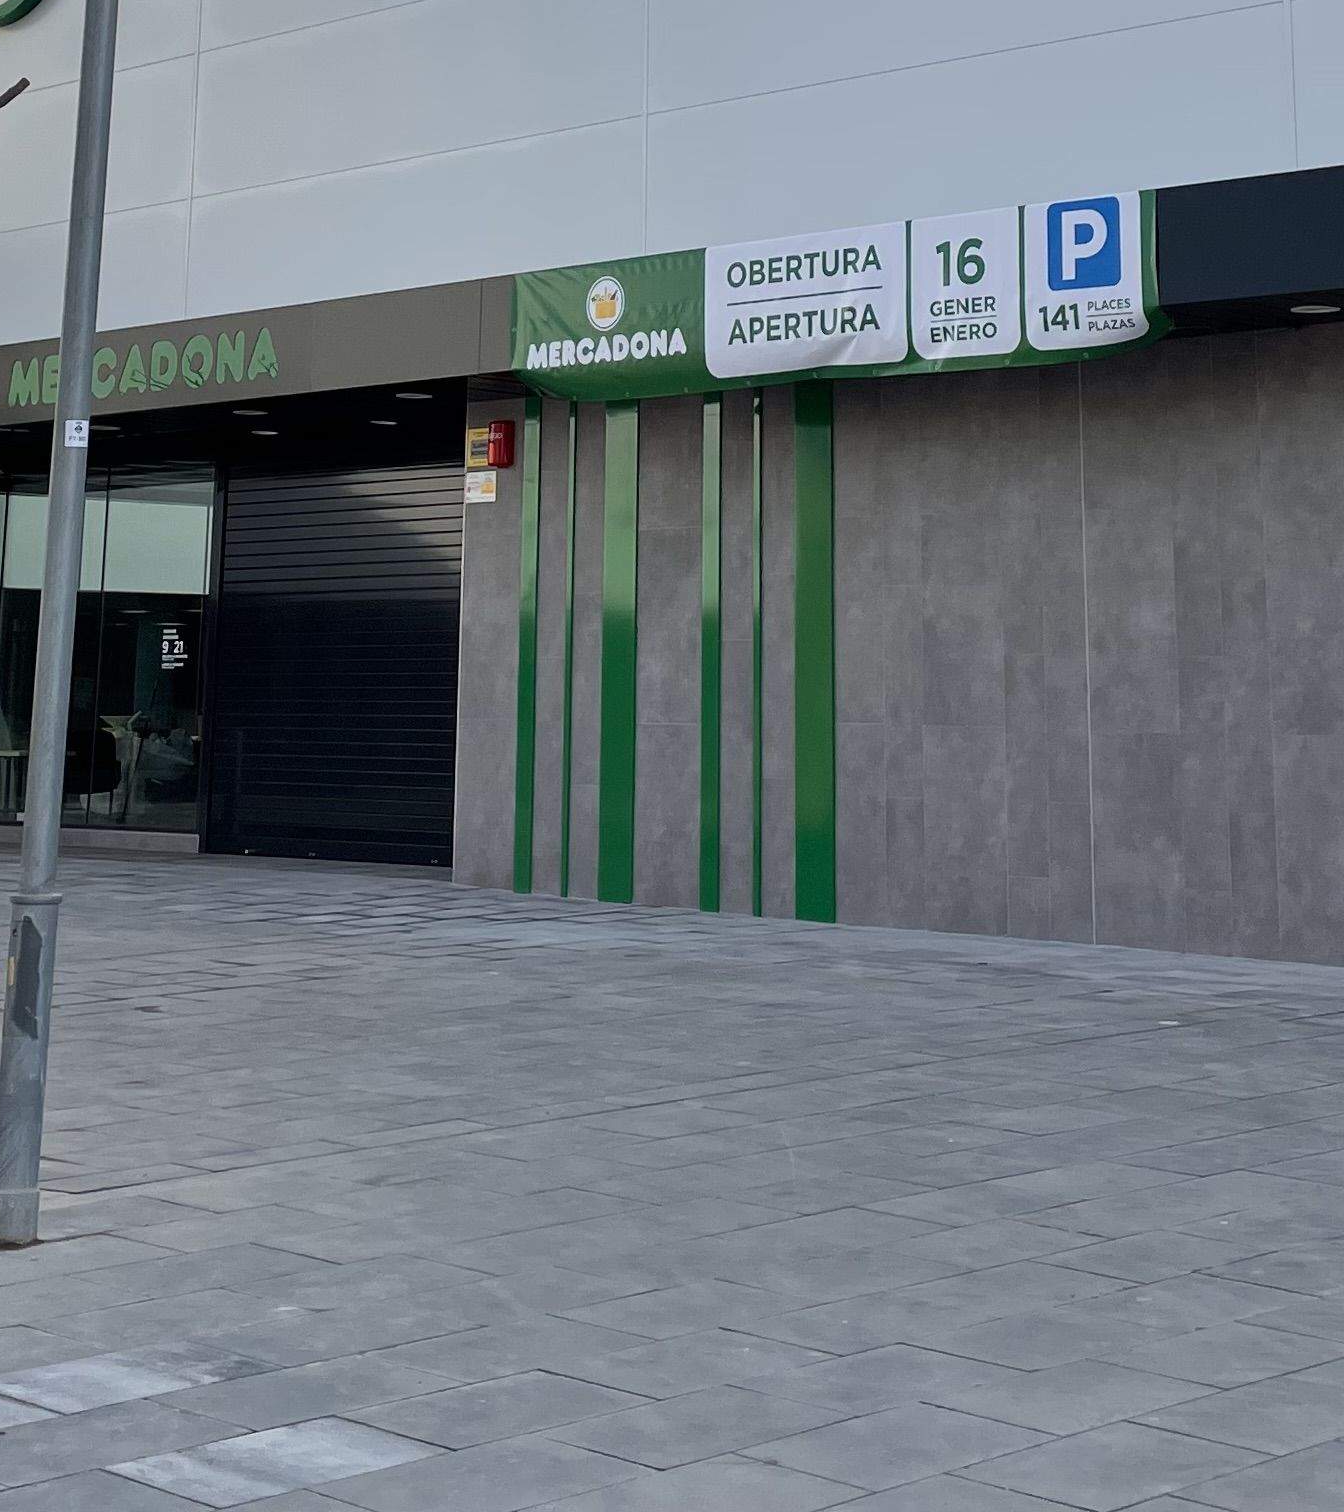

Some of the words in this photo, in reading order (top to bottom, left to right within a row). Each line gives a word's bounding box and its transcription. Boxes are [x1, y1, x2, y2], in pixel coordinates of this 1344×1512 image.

[936, 237, 986, 287] 16
[1061, 208, 1108, 281] P
[726, 244, 883, 289] OBERTURA
[727, 303, 881, 346] APERTURA
[929, 295, 997, 317] GENER
[1038, 302, 1081, 332] 141
[1086, 297, 1132, 312] PLACES
[1087, 318, 1136, 332] PLAZAS
[526, 327, 688, 370] MERCADONA
[929, 321, 998, 344] ENERO
[8, 327, 279, 407] MECADONA
